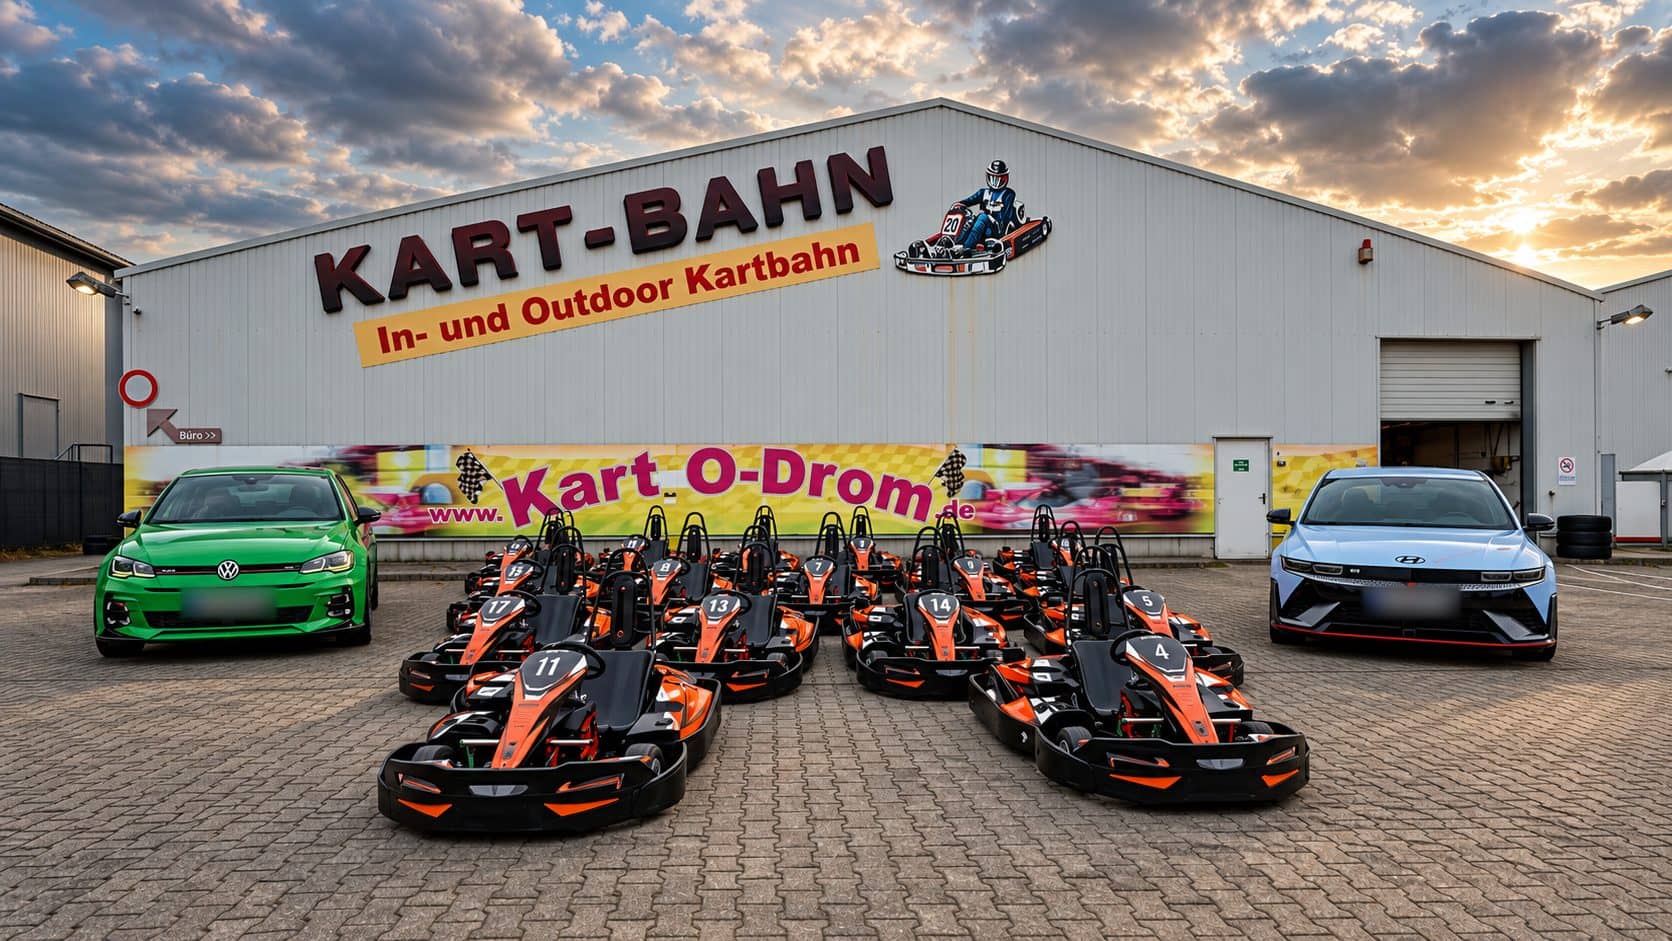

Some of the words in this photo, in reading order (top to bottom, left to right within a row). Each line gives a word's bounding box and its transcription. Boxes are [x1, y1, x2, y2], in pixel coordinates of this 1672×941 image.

[314, 145, 894, 314] KART-BAHN
[943, 217, 960, 234] 20
[377, 326, 428, 354] In-
[439, 303, 511, 341] und
[521, 277, 674, 325] Outdoor
[684, 241, 861, 295] Kartbahn
[179, 431, 203, 441] Büro
[428, 507, 504, 523] www.
[501, 450, 661, 529] Kart
[685, 446, 934, 523] O-Drom
[814, 562, 822, 572] 7
[487, 600, 506, 615] 17
[709, 599, 729, 613] 13
[930, 598, 951, 612] 14
[1141, 595, 1153, 607] 5
[1155, 643, 1170, 660] 4
[535, 656, 561, 676] 11
